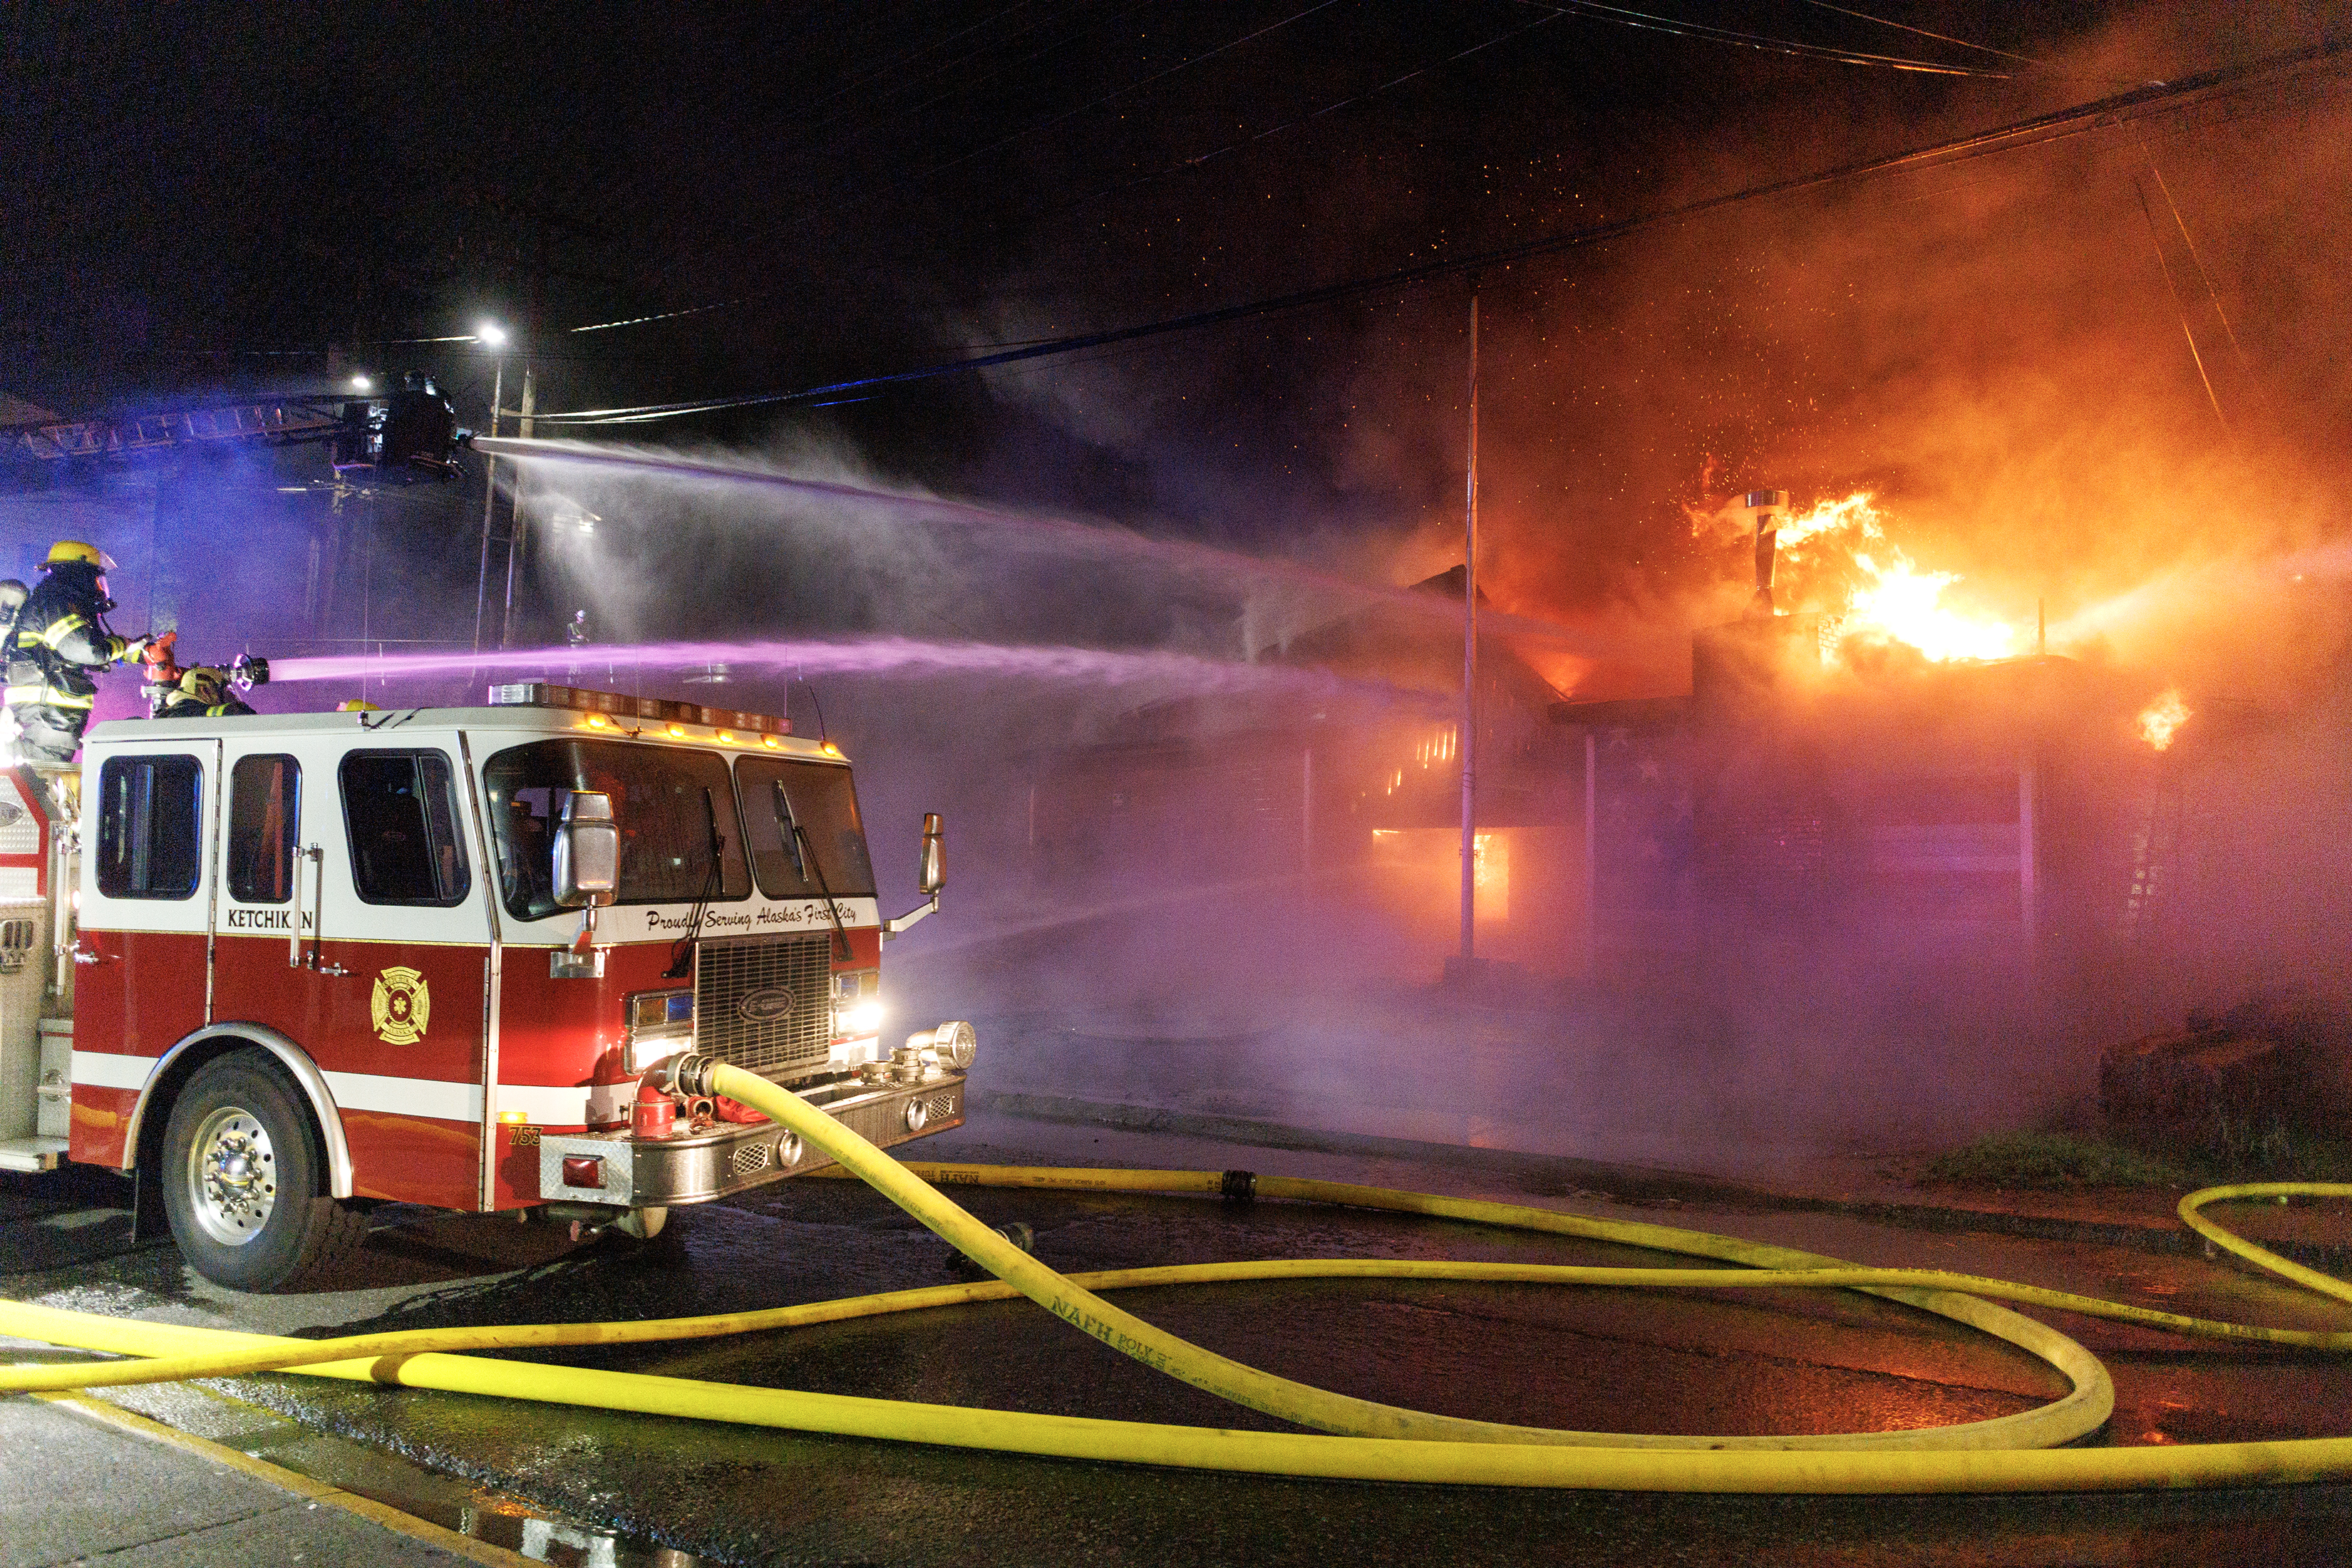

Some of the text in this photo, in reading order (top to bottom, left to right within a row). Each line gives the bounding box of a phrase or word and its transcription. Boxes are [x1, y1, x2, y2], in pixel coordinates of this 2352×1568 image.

[228, 909, 312, 929] KETCHIKN
[646, 902, 857, 931] Proud Serving Alaska's First City
[508, 1125, 544, 1146] 753
[1052, 1295, 1113, 1341] NAFH
